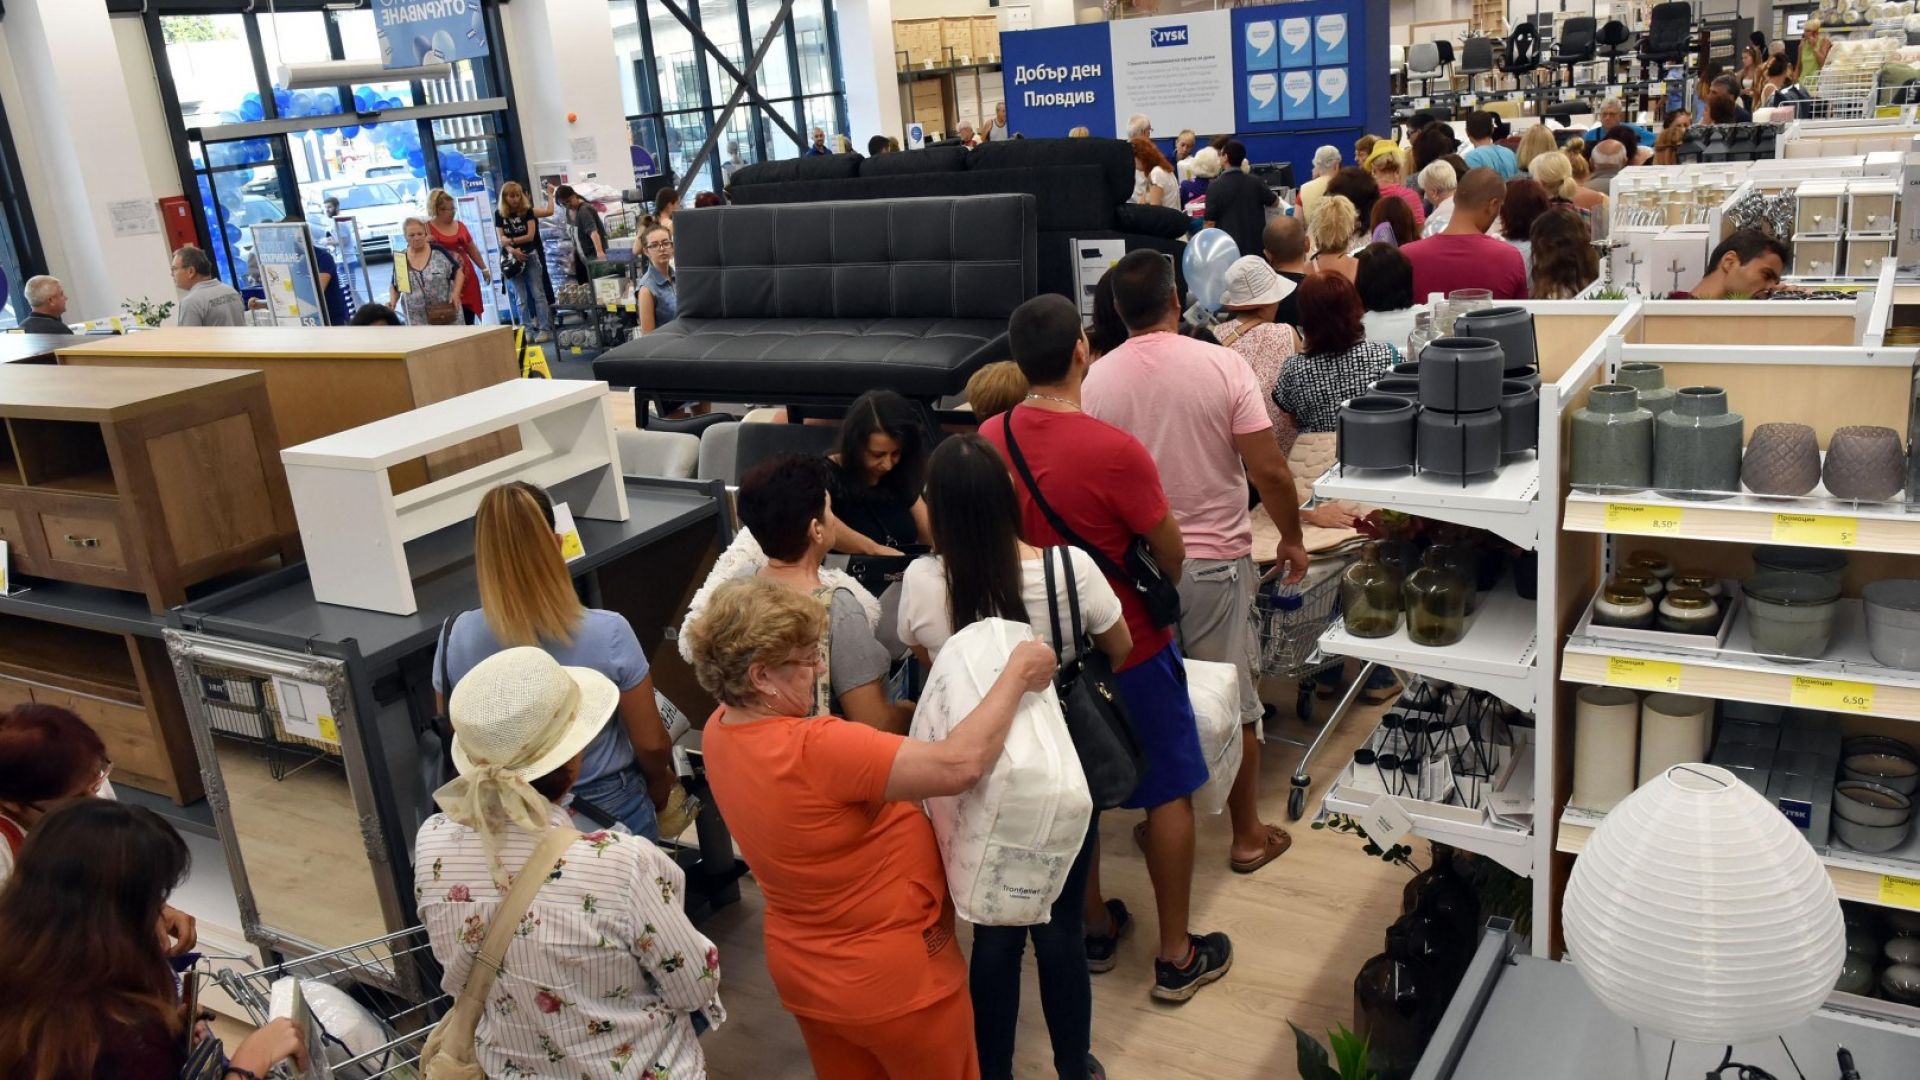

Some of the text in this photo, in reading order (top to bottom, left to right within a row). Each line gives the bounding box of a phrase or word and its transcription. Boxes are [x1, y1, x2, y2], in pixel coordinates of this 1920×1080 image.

[1158, 30, 1187, 42] JYSK
[1014, 63, 1068, 86] Добър
[1070, 63, 1102, 81] ден
[1024, 90, 1095, 108] Пловдив
[1609, 503, 1644, 512] Промоция
[1776, 514, 1815, 523] Промоция
[1610, 657, 1645, 666] Промоция
[1795, 677, 1833, 687] Промоция
